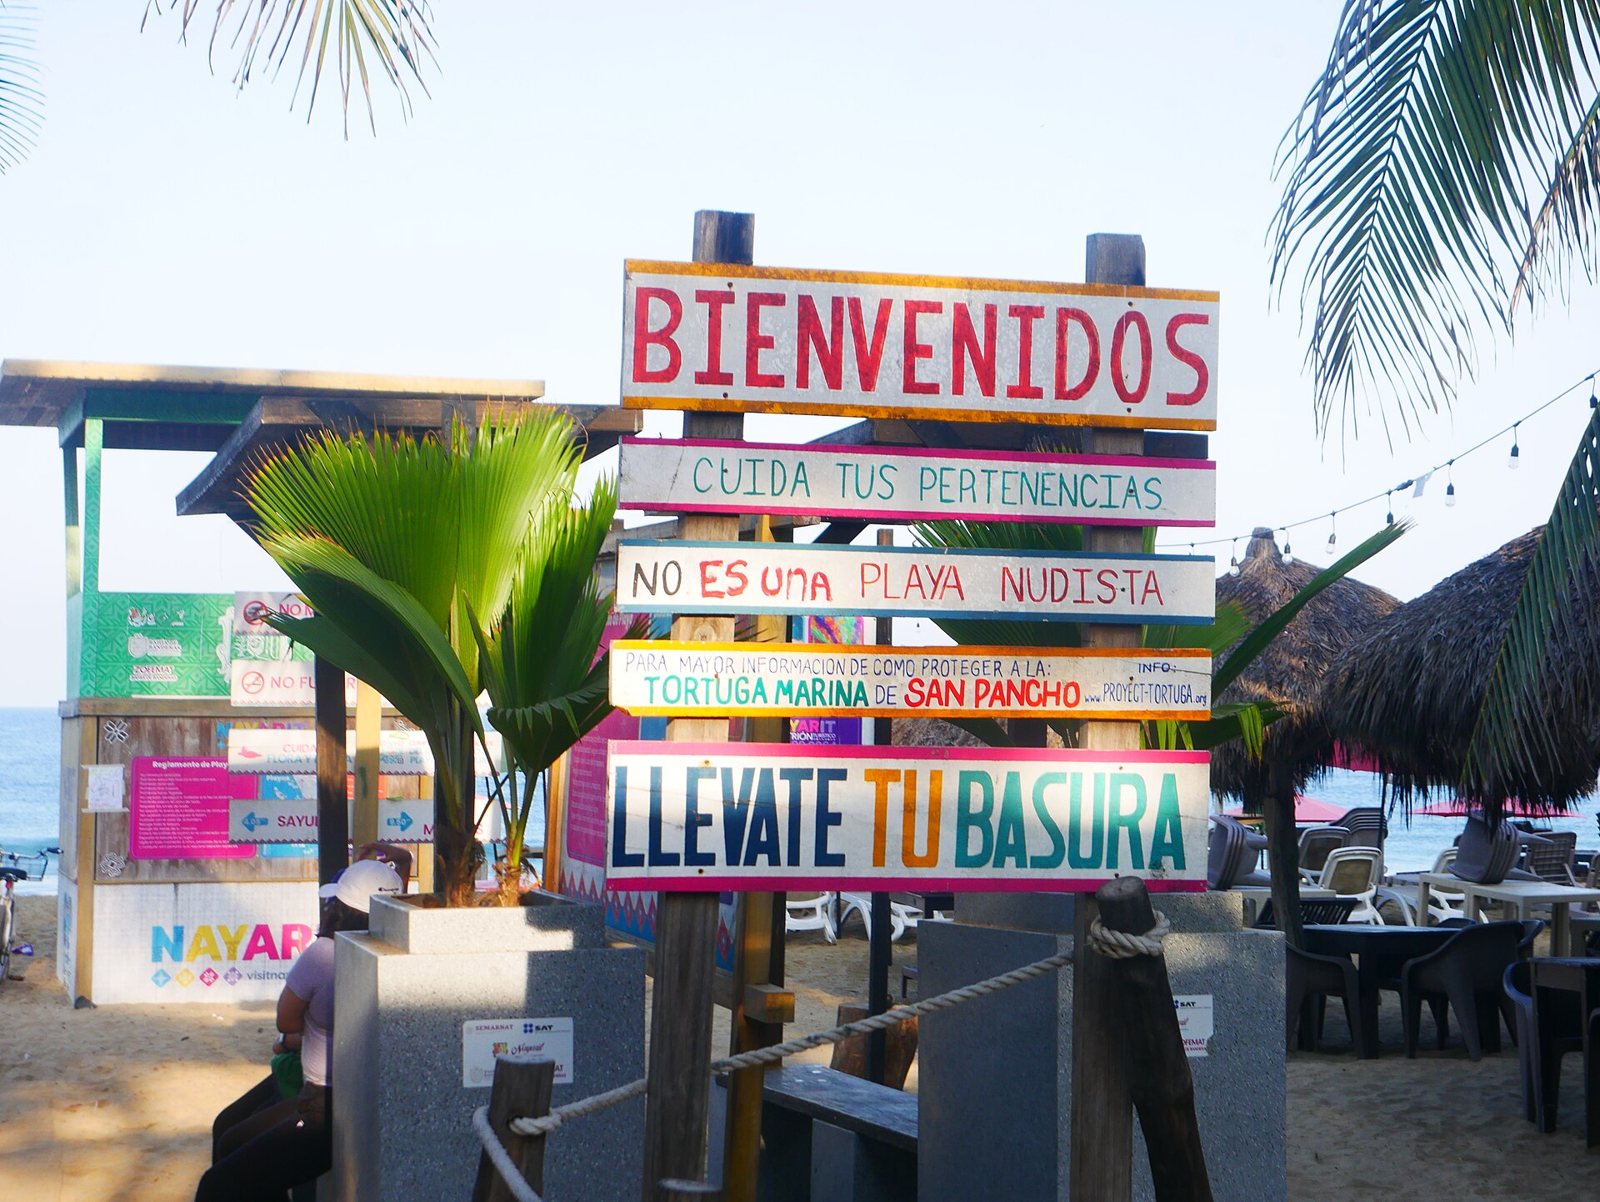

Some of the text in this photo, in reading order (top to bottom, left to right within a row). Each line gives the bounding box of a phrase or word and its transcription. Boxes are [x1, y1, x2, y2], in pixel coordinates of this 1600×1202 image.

[632, 286, 1210, 406] BIENVENIDOS
[693, 457, 1165, 510] CUIDA TUS PERTENENCIAS
[632, 560, 682, 597] NO
[699, 559, 749, 599] ES
[861, 562, 965, 601] PLAYA
[1001, 566, 1164, 606] NUDISTA
[278, 602, 301, 616] NO
[271, 676, 356, 689] NO FUR
[625, 651, 1051, 678] PARA MAYOR INFORMACION DE COMO PROTEGER A LA:
[1138, 661, 1177, 674] INFO:
[644, 675, 768, 706] TORTUGA
[774, 677, 869, 708] MARINA
[875, 684, 898, 706] DE
[904, 677, 966, 708] SAN
[974, 677, 1081, 709] PANCHO
[612, 765, 847, 868] LLEVATE
[863, 768, 944, 869] TU
[954, 769, 1187, 871] BASURA
[151, 923, 314, 963] NAYAR
